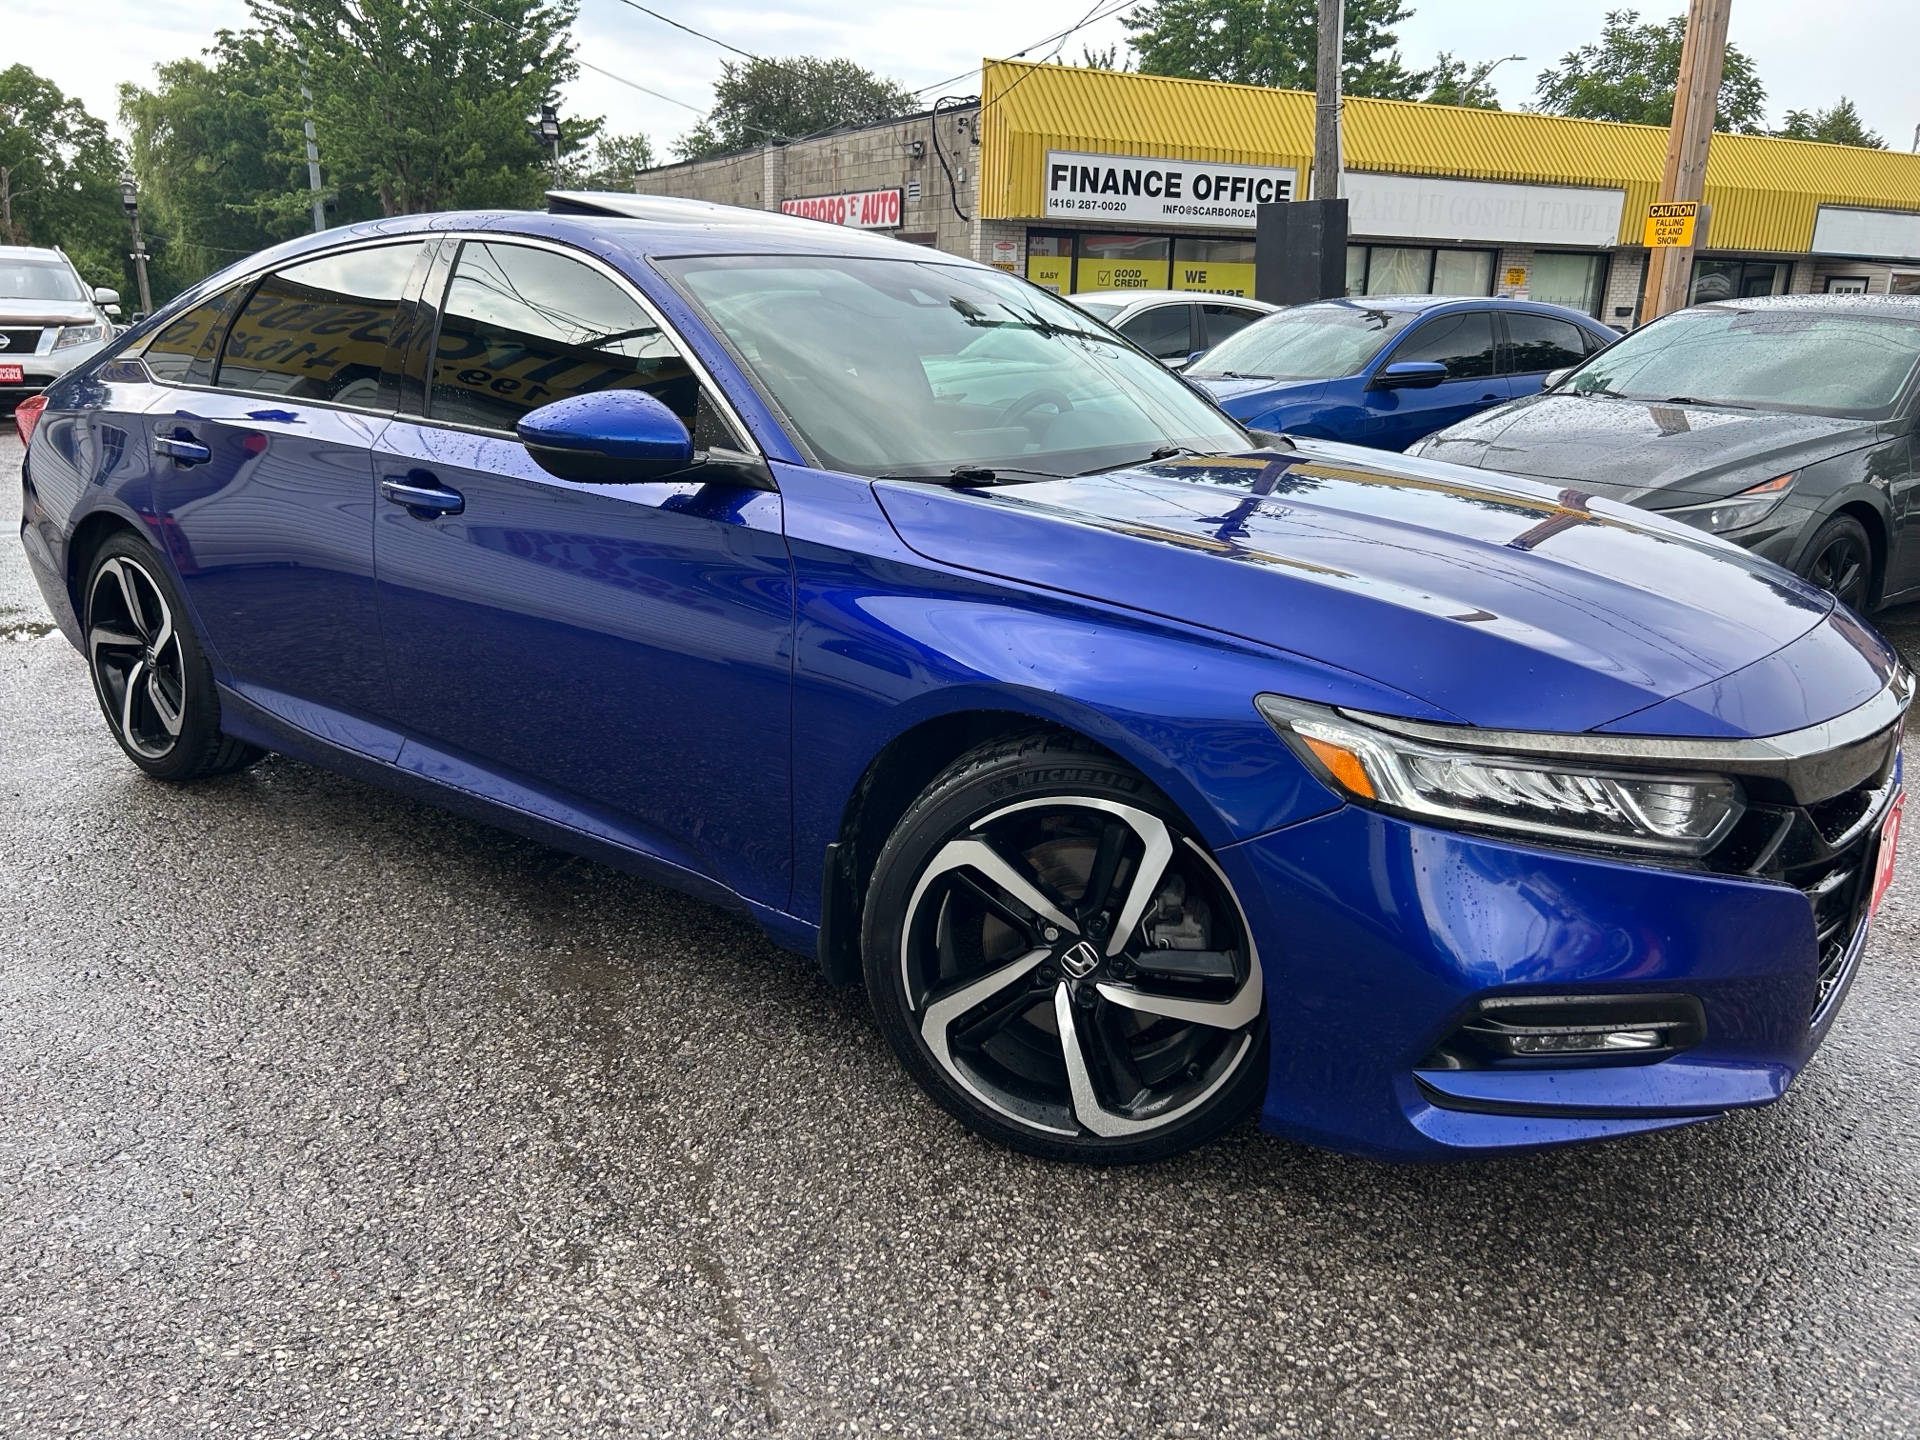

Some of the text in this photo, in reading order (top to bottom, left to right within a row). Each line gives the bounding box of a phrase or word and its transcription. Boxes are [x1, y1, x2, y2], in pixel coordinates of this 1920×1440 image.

[1050, 164, 1291, 203] FINANCE OFFICE
[861, 191, 899, 225] AUTO
[1049, 198, 1075, 209] (416)
[1078, 199, 1127, 212] 287-0020
[1650, 205, 1695, 217] CAUTION
[1655, 218, 1685, 227] FALLING
[1655, 227, 1683, 236] ICE AND
[1656, 236, 1679, 245] SNOW
[1040, 271, 1059, 279] EASY
[1114, 269, 1142, 278] GOOD
[1185, 270, 1207, 284] WE
[1114, 278, 1149, 288] CREDIT
[1017, 769, 1138, 791] MICHELIN
